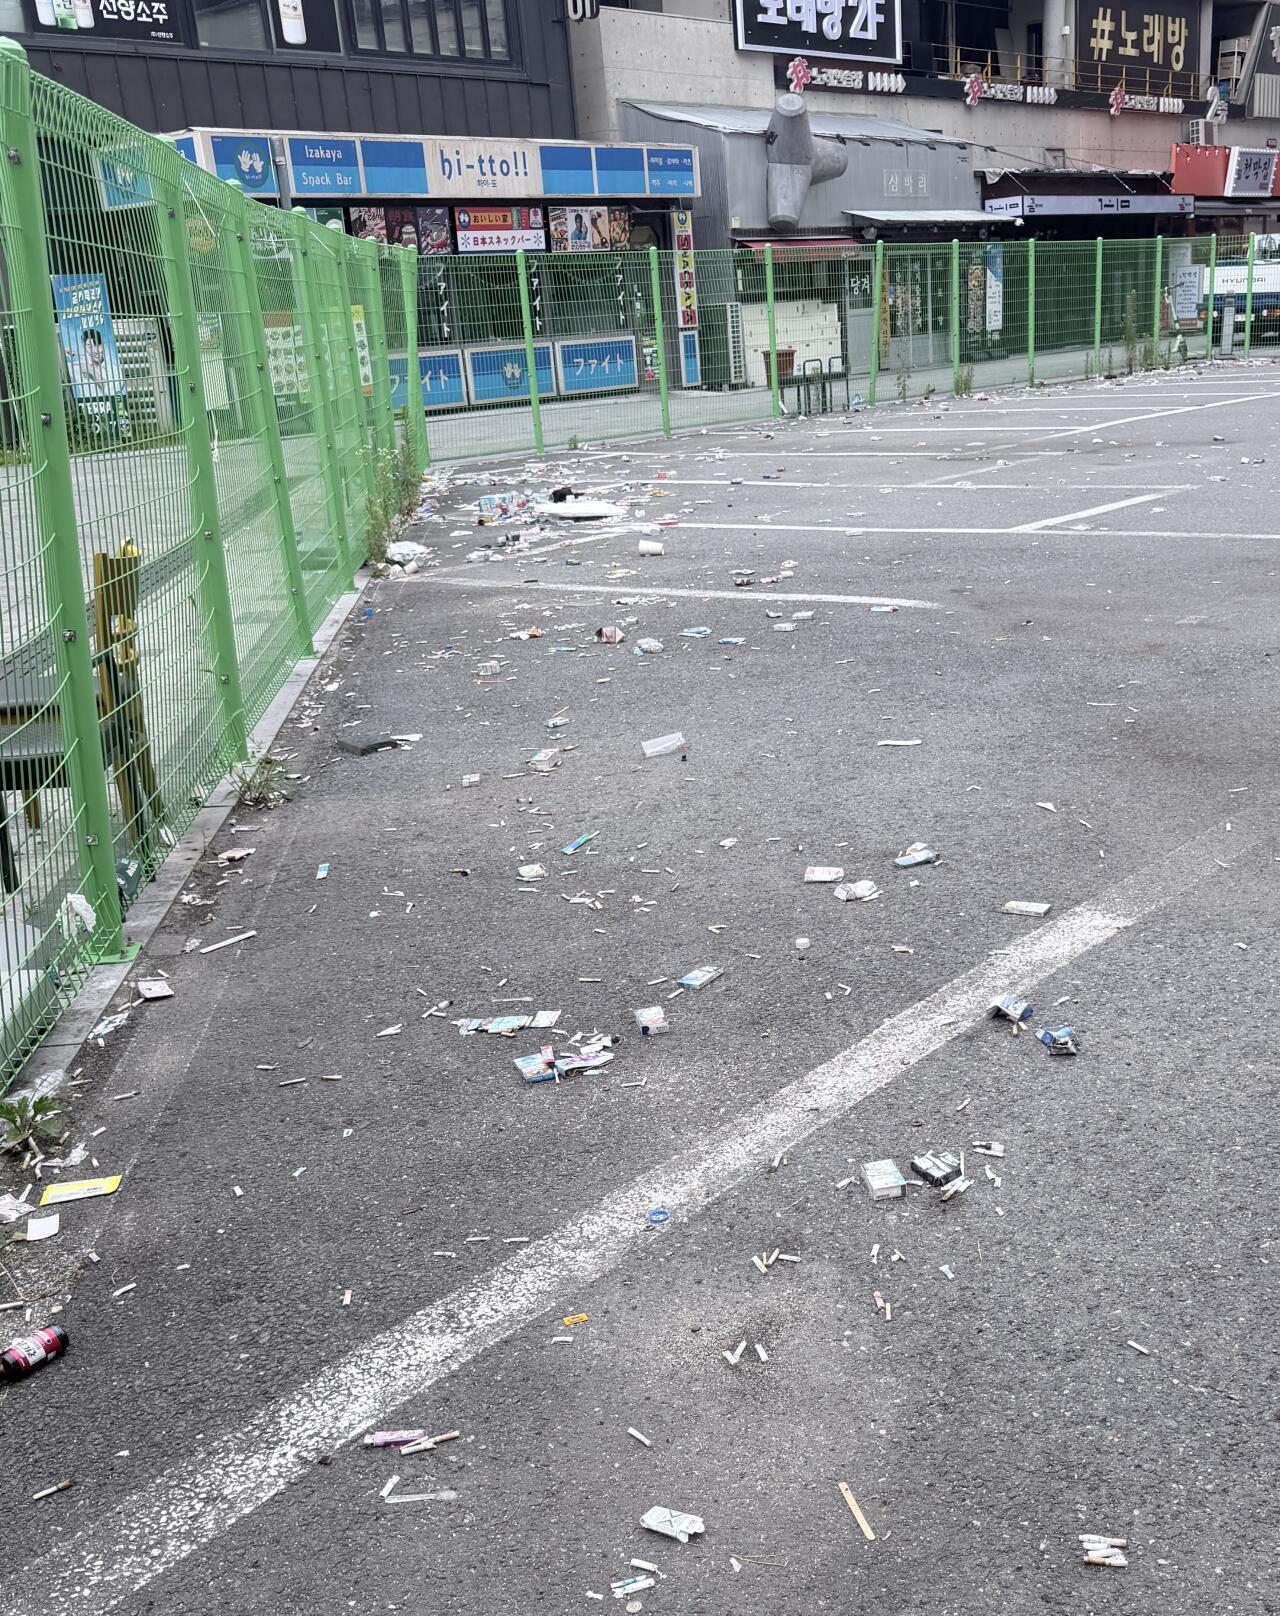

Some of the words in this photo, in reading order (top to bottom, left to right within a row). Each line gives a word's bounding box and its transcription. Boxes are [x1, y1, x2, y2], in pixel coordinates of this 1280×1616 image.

[99, 0, 169, 24] 선양소주
[305, 145, 342, 163] Izakaya
[302, 173, 332, 187] Snack
[336, 174, 353, 185] Bar
[573, 353, 624, 376] ファイト
